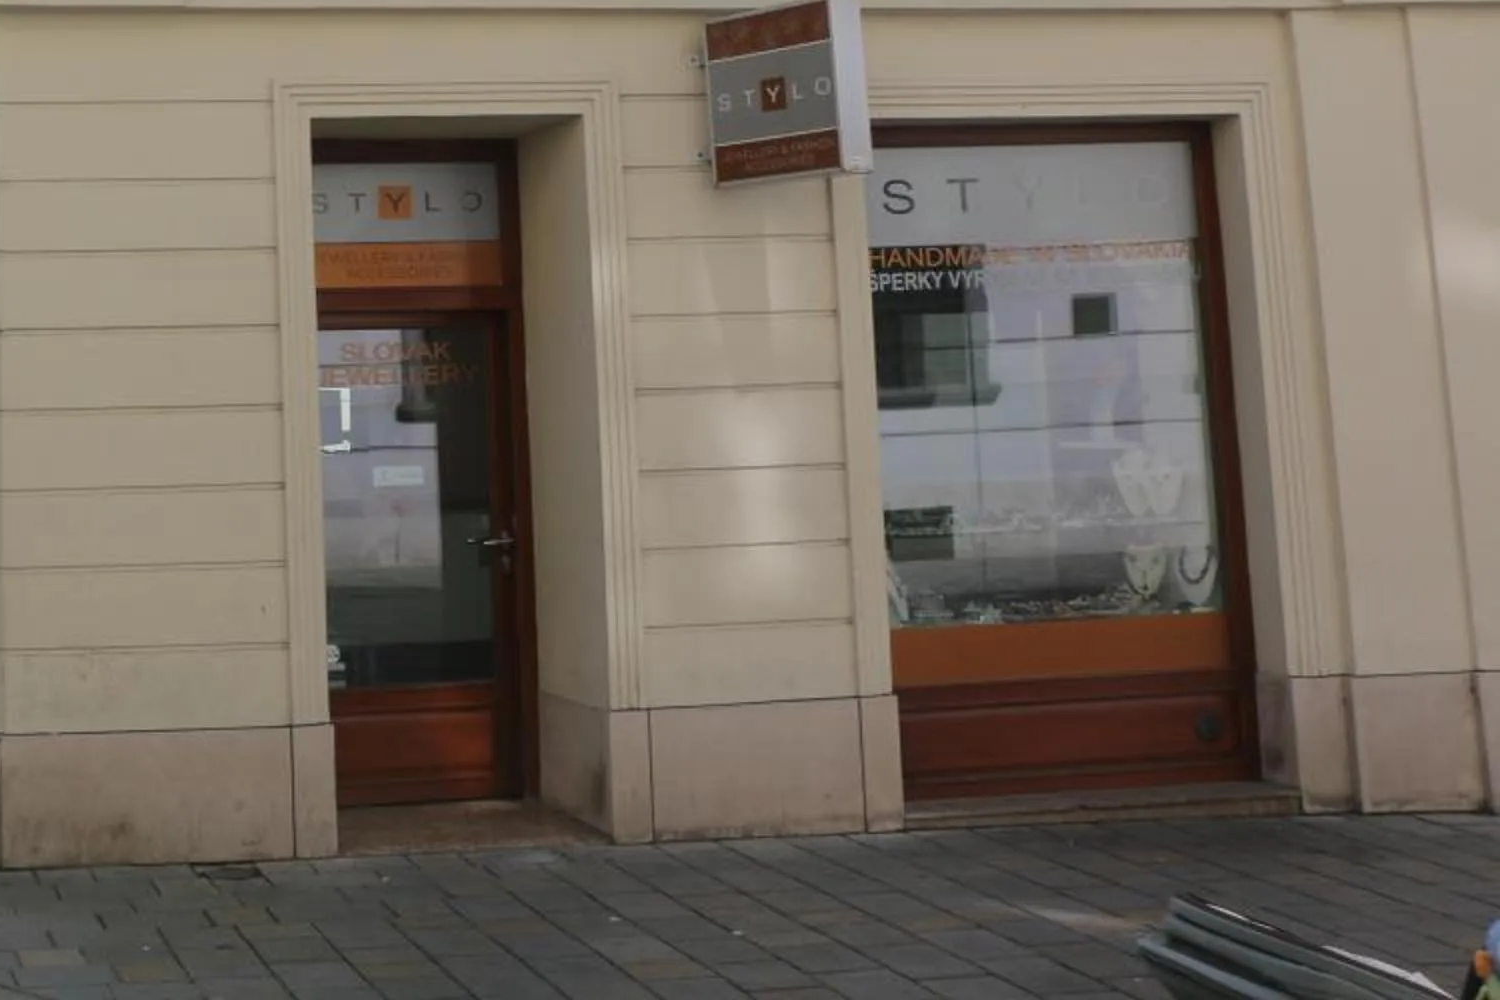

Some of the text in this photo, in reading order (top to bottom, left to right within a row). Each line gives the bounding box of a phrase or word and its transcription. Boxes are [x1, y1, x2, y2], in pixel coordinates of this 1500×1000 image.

[717, 75, 832, 113] STYLO
[312, 190, 484, 214] STYLO
[340, 339, 452, 363] SLOVAK
